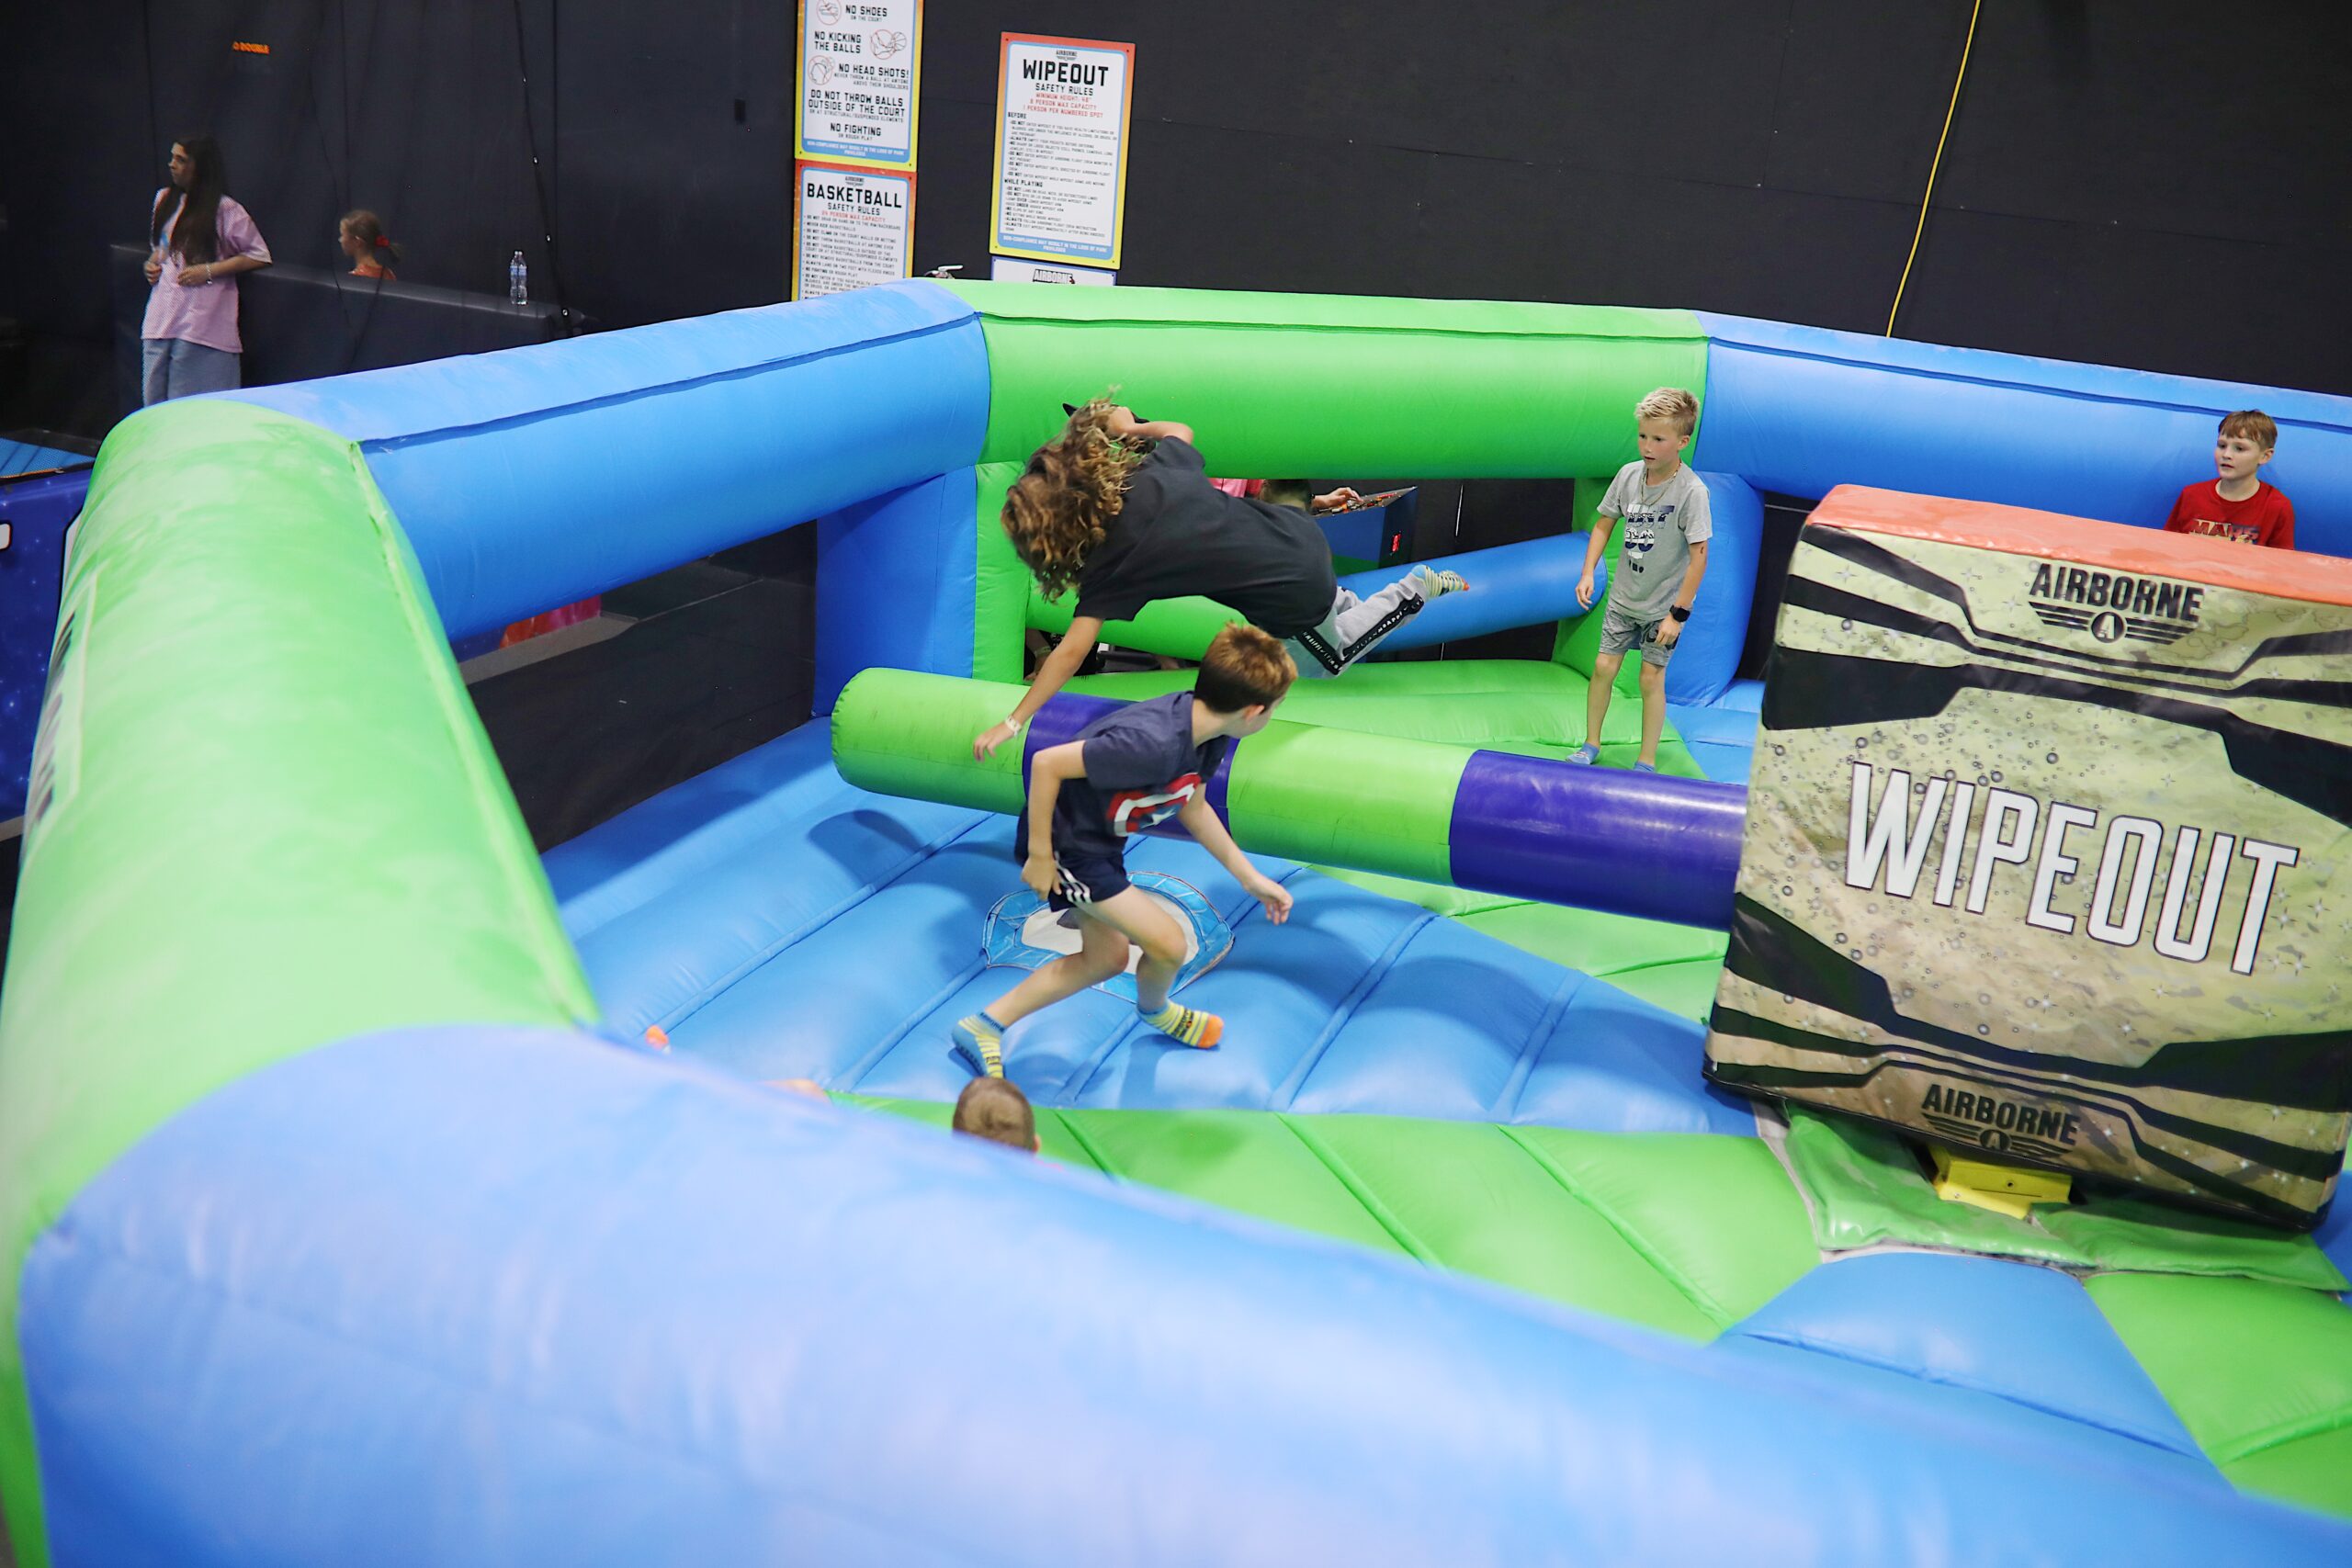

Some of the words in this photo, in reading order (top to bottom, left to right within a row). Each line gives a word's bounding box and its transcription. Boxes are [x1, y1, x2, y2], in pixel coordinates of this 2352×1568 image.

[846, 5, 856, 14] NO
[860, 6, 888, 17] SHOES
[814, 31, 825, 39] NO
[830, 32, 861, 43] KICKING
[815, 41, 829, 51] THE
[833, 42, 860, 53] BALLS
[854, 65, 875, 74] HEAD
[878, 68, 909, 78] SHOTS!
[1023, 59, 1108, 86] WIPEOUT
[1036, 83, 1065, 93] SAFETY
[1069, 86, 1093, 96] RULES
[811, 89, 821, 97] DO
[825, 91, 840, 99] NOT
[845, 93, 872, 103] THROW
[876, 96, 903, 107] BALLS
[808, 99, 842, 110] OUTSIDE
[846, 103, 854, 111] OF
[860, 105, 874, 114] THE
[878, 107, 904, 117] COURT
[831, 123, 841, 131] NO
[845, 124, 881, 136] FIGHTING
[808, 183, 901, 208] BASKETBALL
[828, 202, 854, 210] SAFETY
[858, 207, 880, 215] RULES
[2029, 562, 2204, 623] AIRBORNE
[1845, 761, 2300, 976] WIPEOUT
[1920, 1083, 2081, 1146] AIRBORNE
